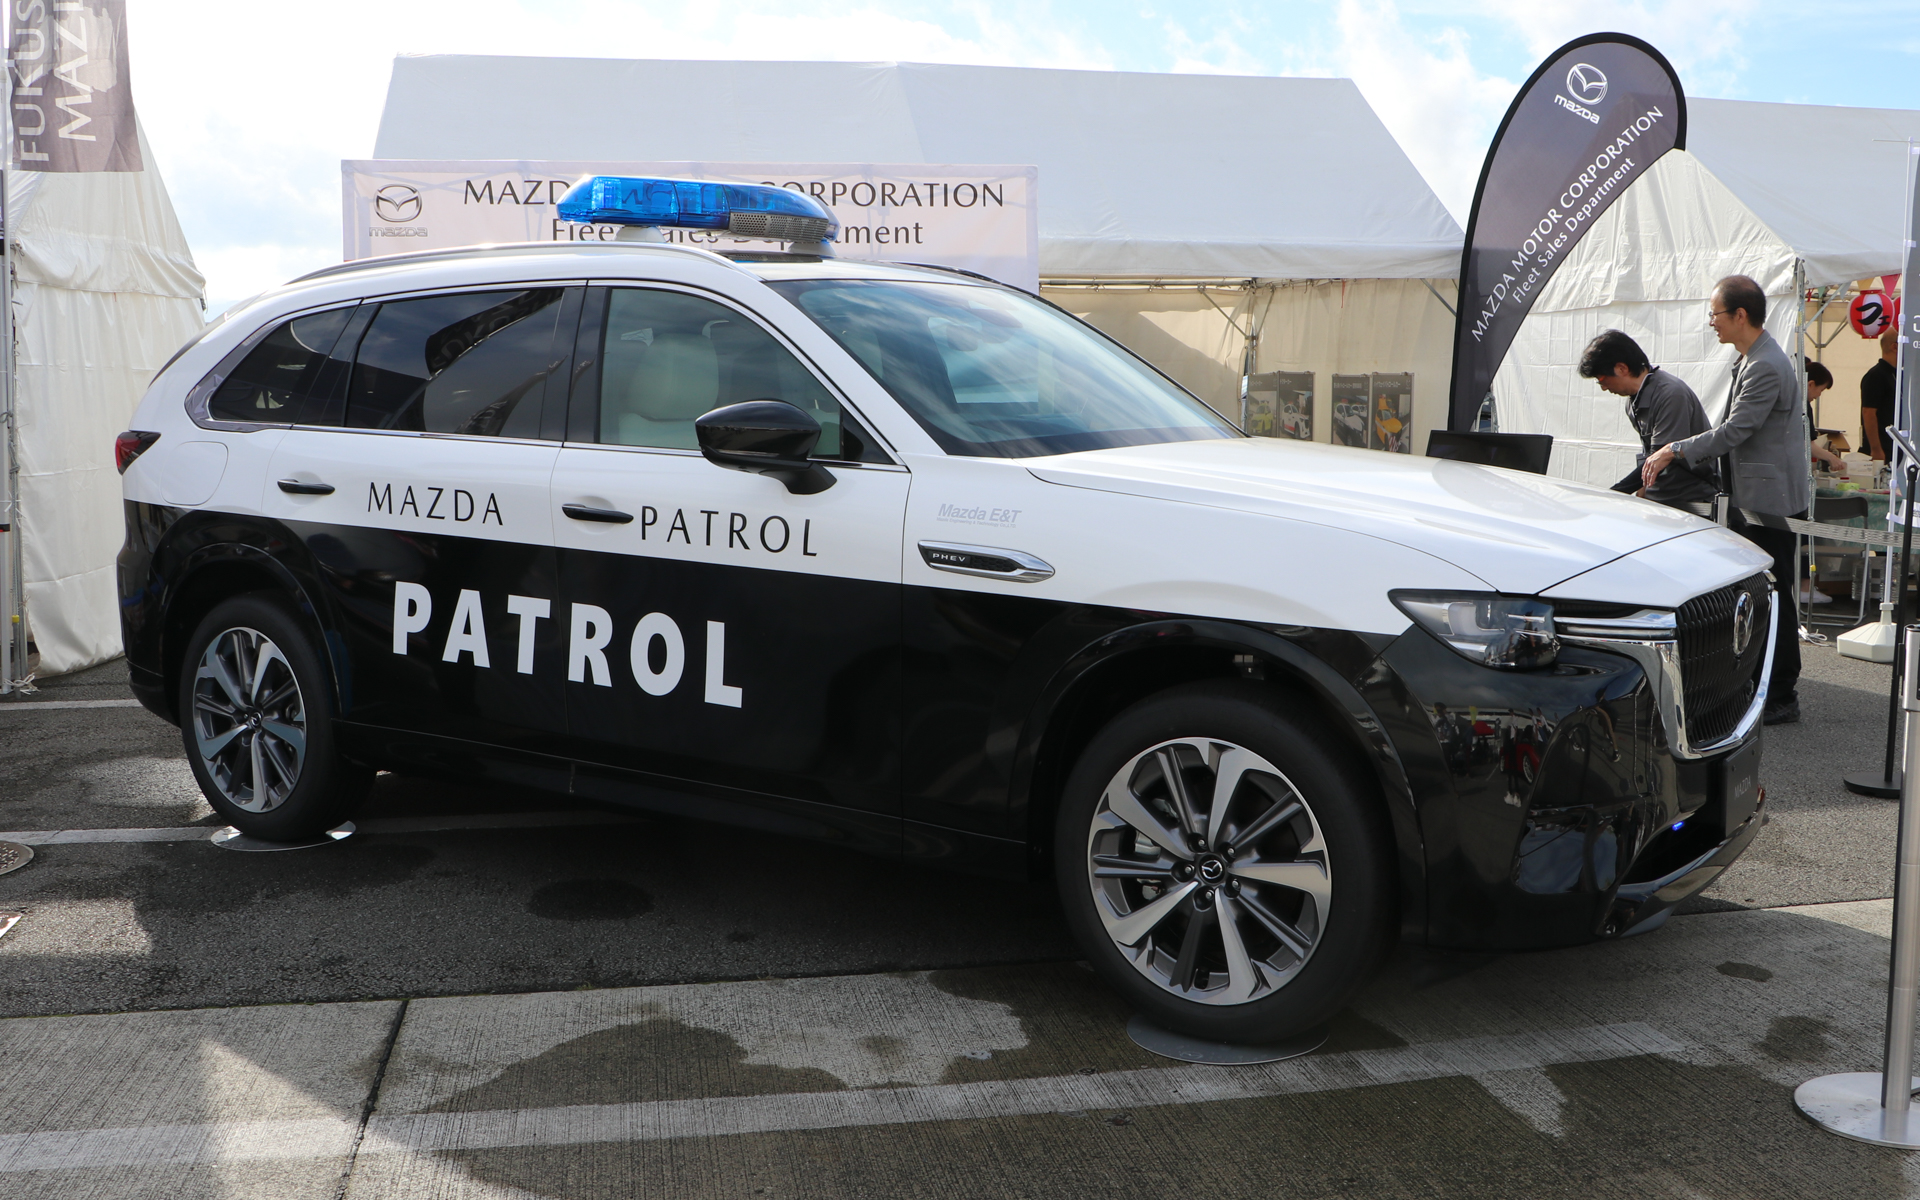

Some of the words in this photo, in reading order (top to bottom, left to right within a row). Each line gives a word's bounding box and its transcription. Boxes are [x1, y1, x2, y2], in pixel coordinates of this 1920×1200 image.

[464, 179, 586, 206] MAZD
[1471, 273, 1515, 342] MAZDA
[1511, 208, 1563, 272] MOTOR
[1560, 105, 1664, 209] CORPORATION
[1512, 266, 1541, 304] Fleet
[1537, 231, 1568, 268] Sales
[1564, 157, 1636, 232] Department
[367, 481, 504, 526] MAZDA
[641, 505, 818, 557] PATROL
[938, 503, 987, 520] Mazda
[989, 507, 1022, 523] E&T
[932, 552, 966, 563] PHEV
[392, 580, 743, 709] PATROL
